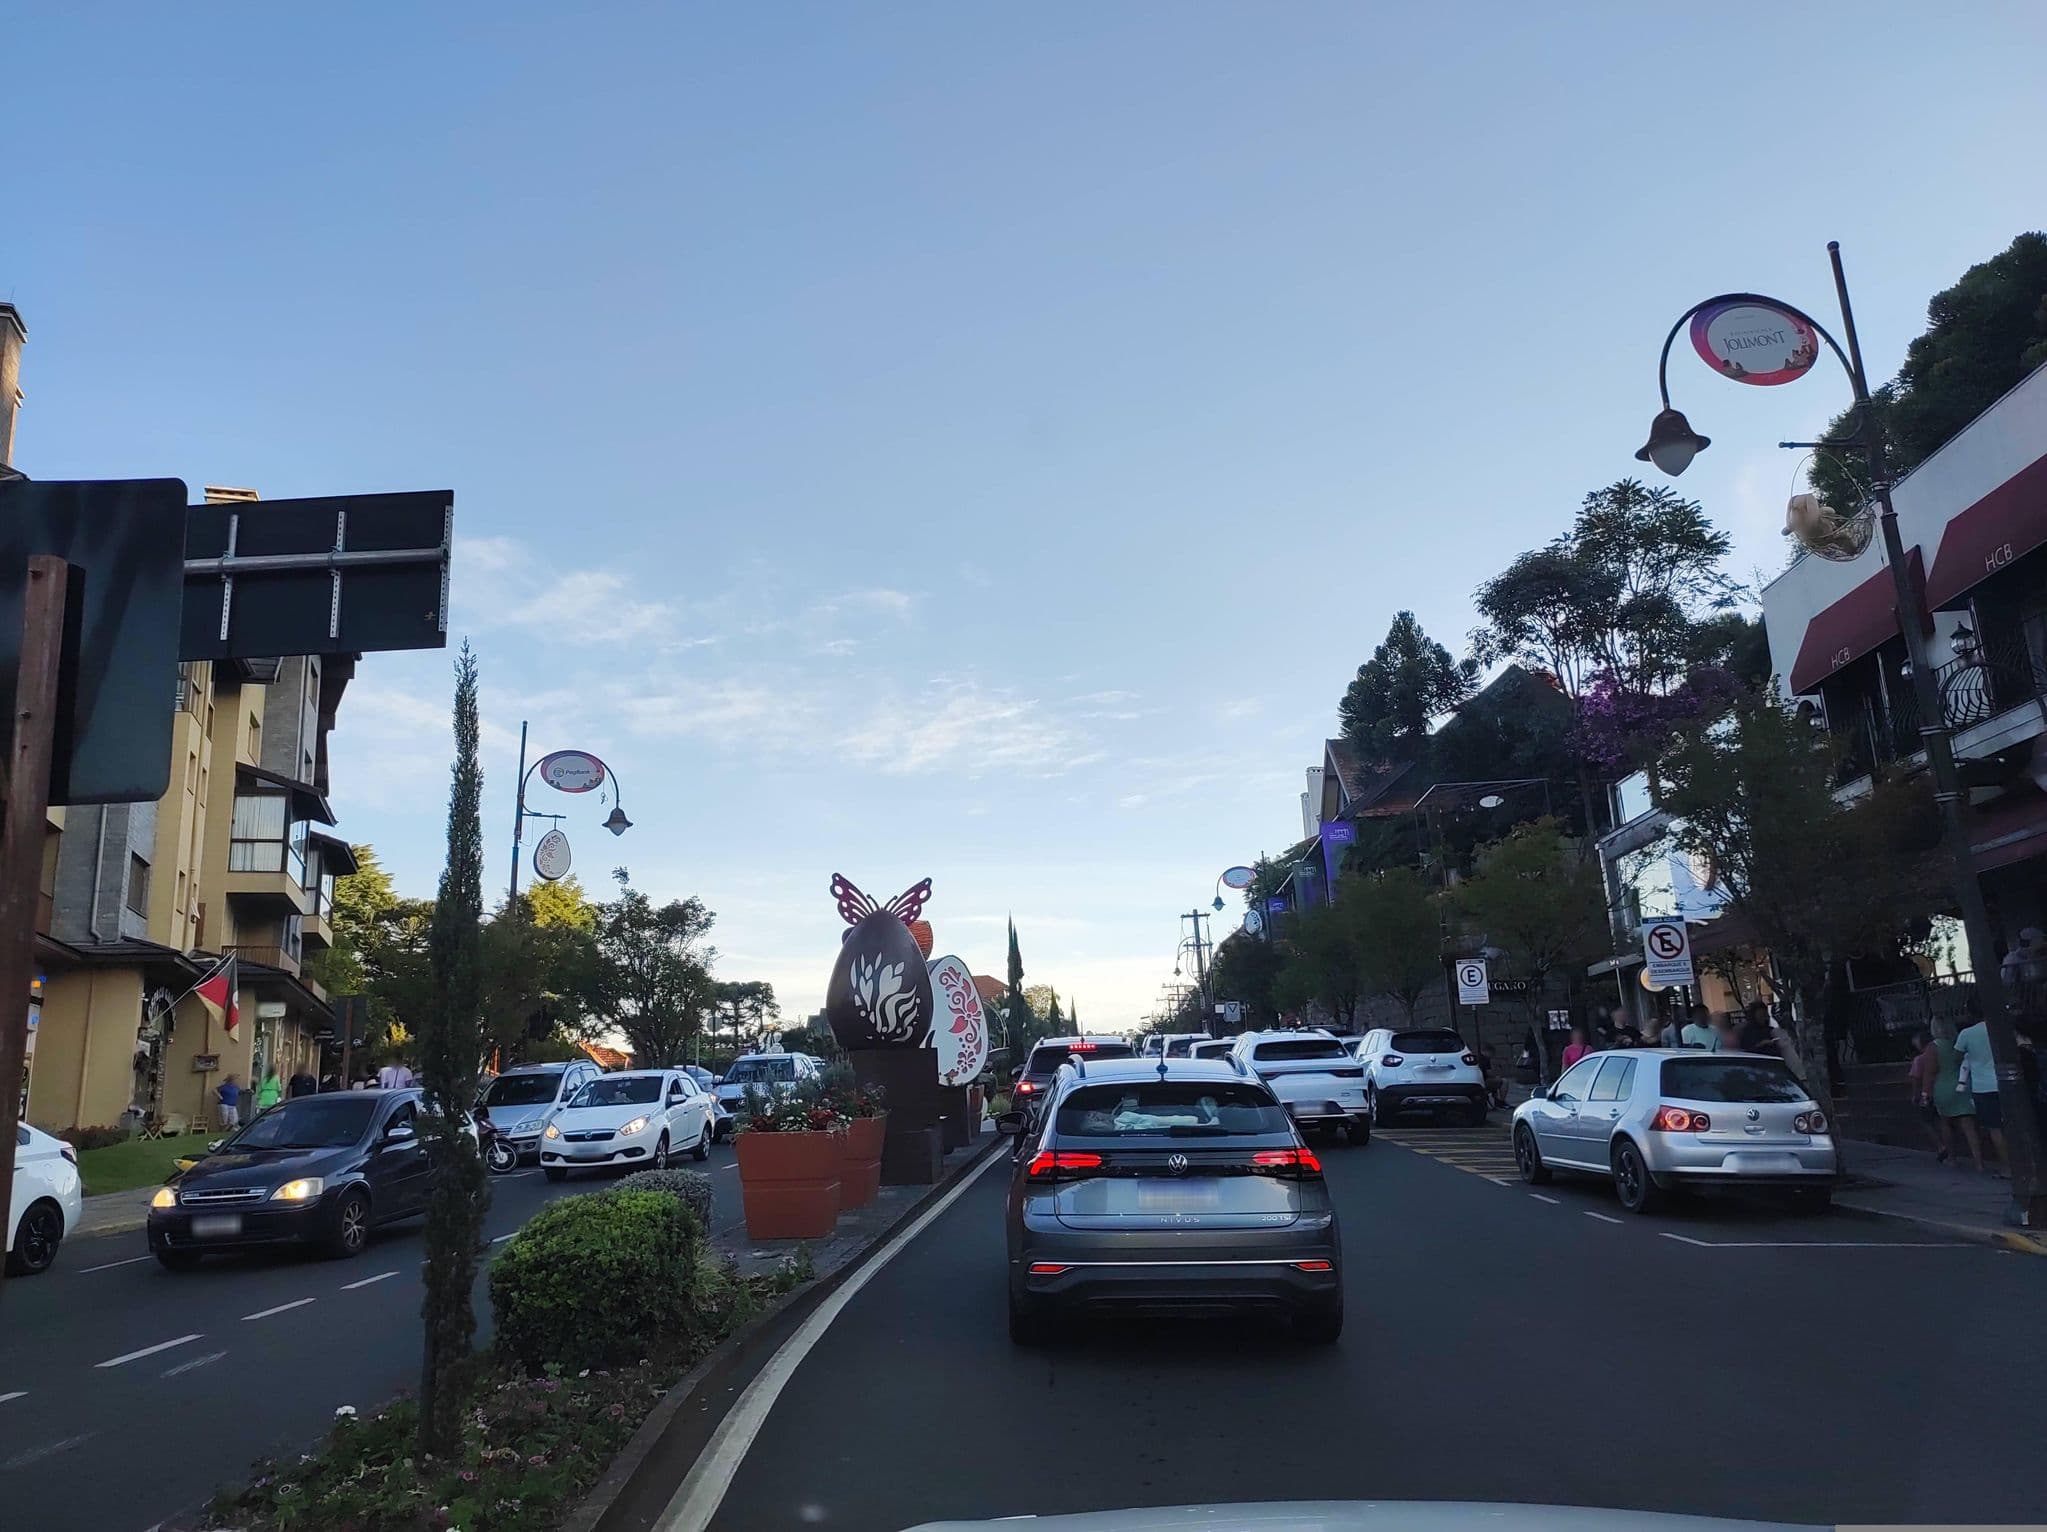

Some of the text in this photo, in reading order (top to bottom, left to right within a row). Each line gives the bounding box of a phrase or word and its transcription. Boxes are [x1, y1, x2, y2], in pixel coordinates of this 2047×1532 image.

[1723, 330, 1785, 353] JOLIMONT
[1985, 543, 2013, 572] HCB
[1831, 647, 1850, 671] HCB
[1160, 1215, 1201, 1224] NIVUS
